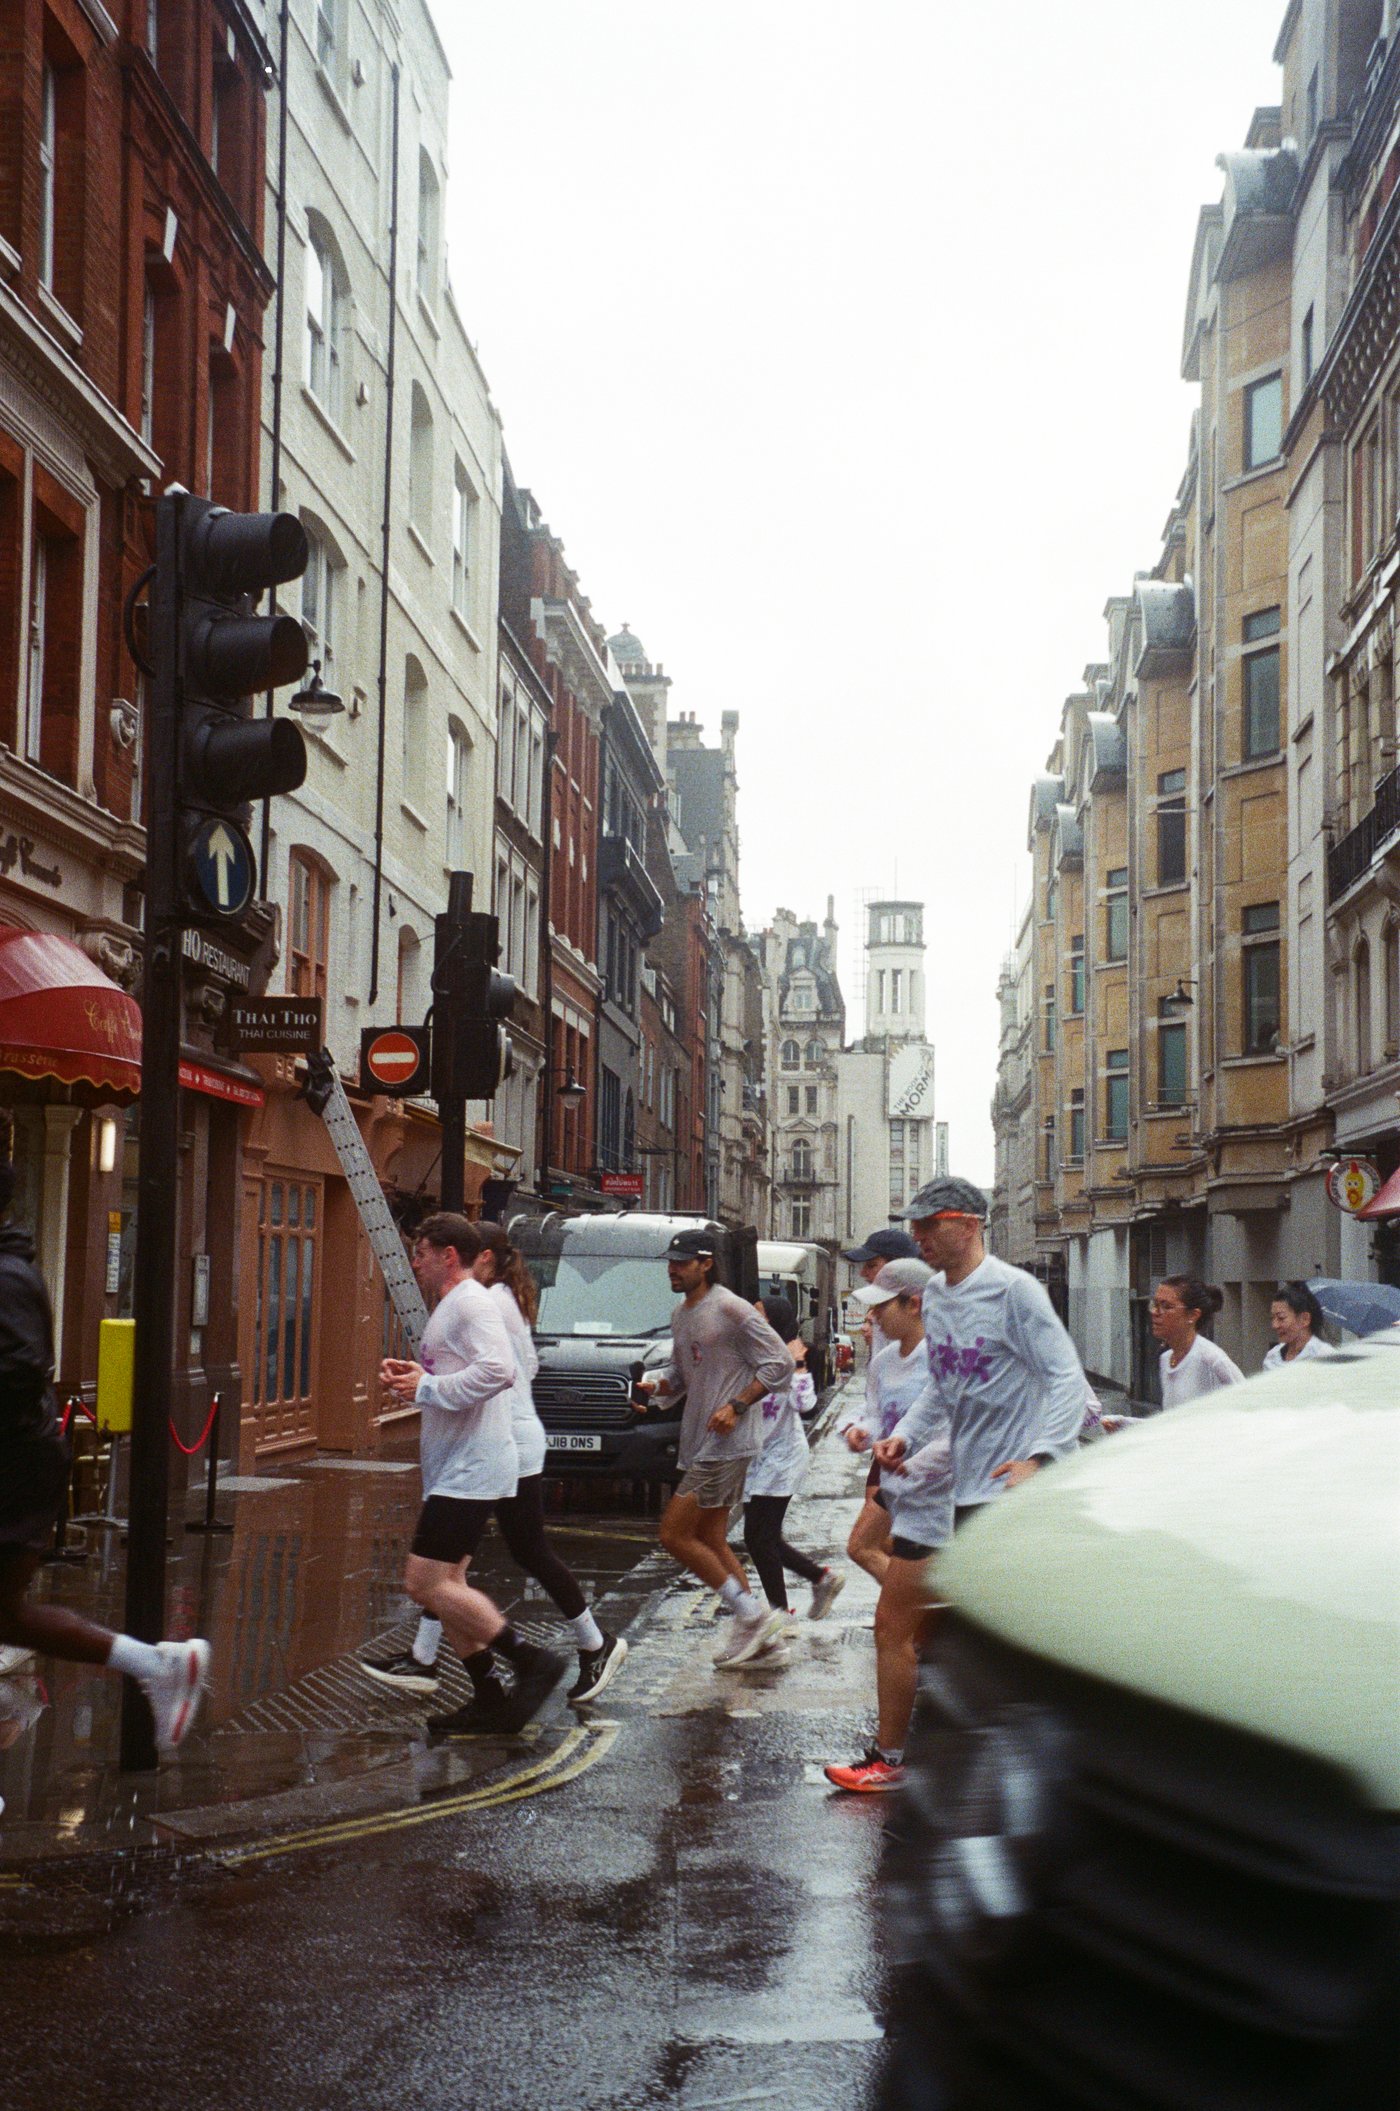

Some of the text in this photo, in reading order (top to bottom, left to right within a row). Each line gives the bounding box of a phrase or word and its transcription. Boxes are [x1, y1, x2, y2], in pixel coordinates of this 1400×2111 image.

[182, 928, 250, 987] HO RESTAURANT
[233, 1009, 317, 1025] THAI THO
[239, 1028, 311, 1041] THAI CUISINE
[546, 1436, 594, 1449] J18 ONS
